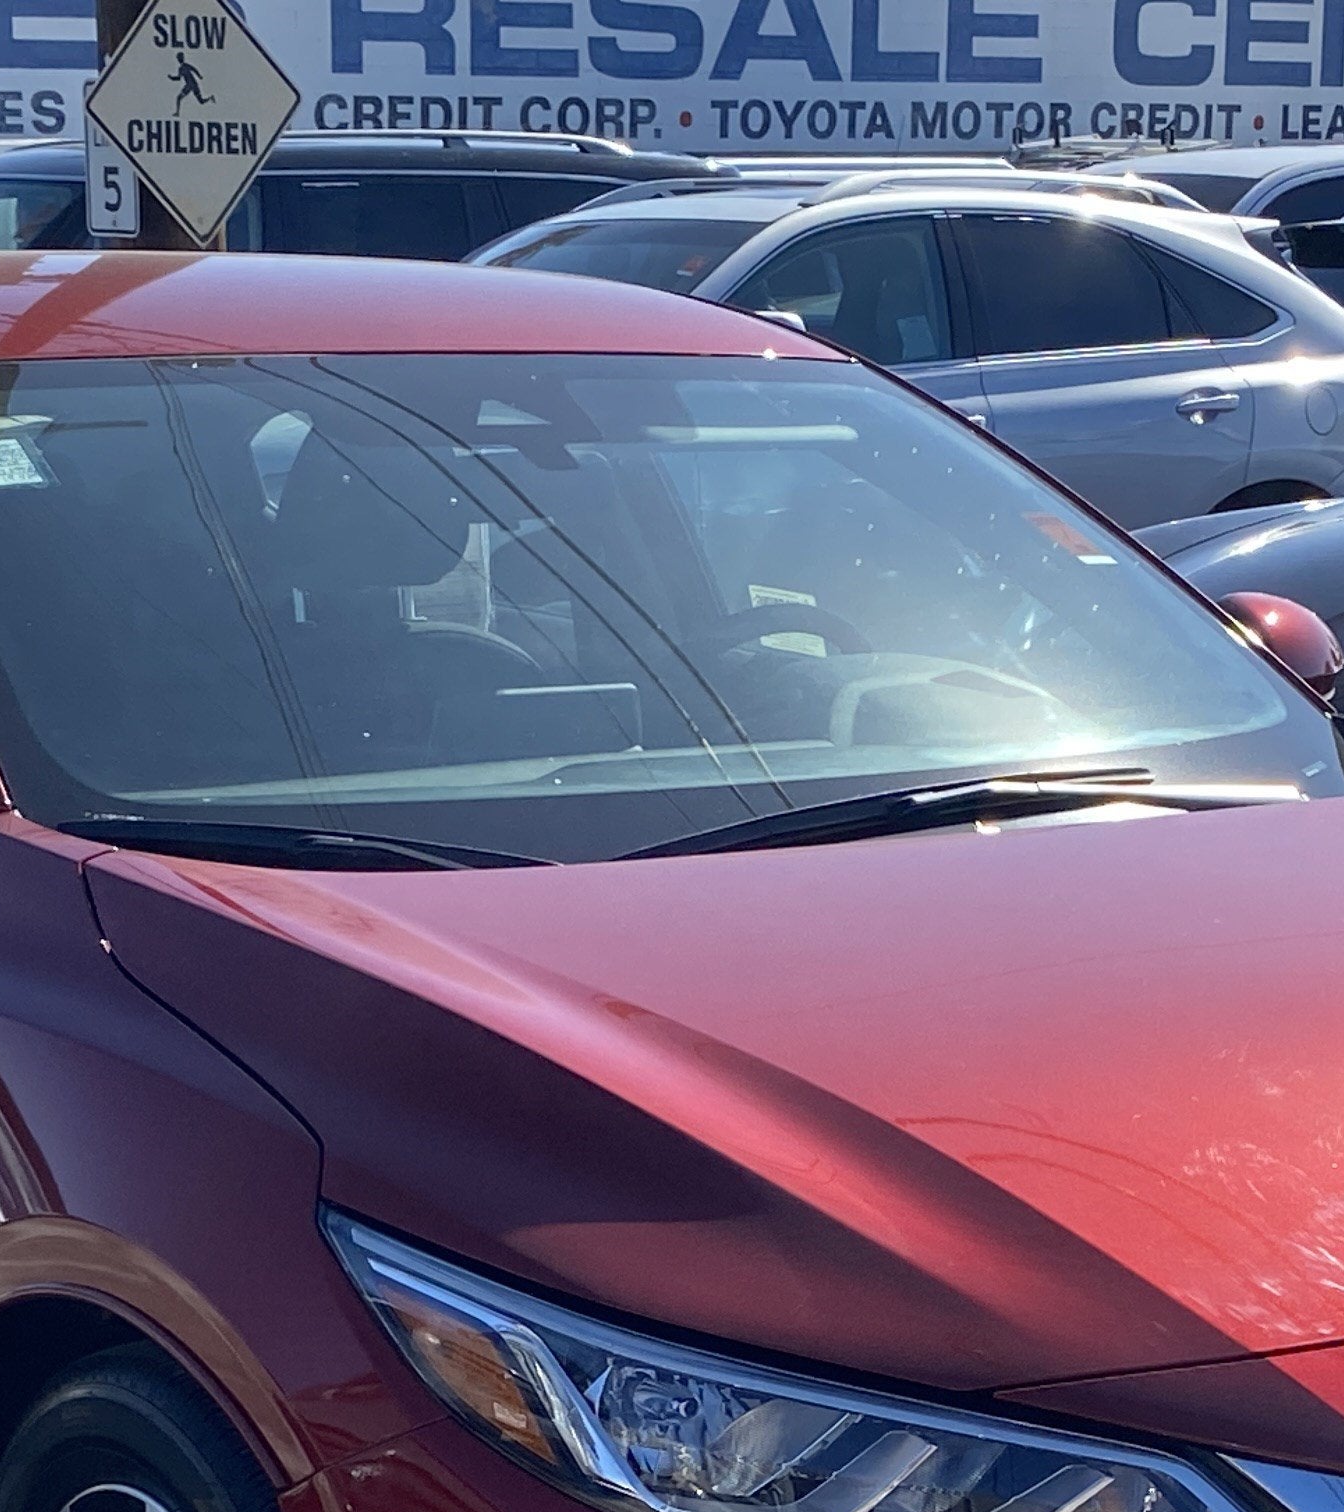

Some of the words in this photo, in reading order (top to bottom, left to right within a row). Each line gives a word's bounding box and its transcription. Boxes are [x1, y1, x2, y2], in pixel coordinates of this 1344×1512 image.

[152, 13, 226, 50] SLOW
[331, 0, 1044, 83] RESALE
[127, 119, 258, 156] CHILDREN
[314, 94, 503, 131] CREDIT
[519, 96, 662, 139] CORP.
[710, 98, 896, 140] TOYOTA
[909, 100, 1073, 140] MOTOR
[1090, 102, 1242, 140] CREDIT
[103, 165, 123, 213] 5
